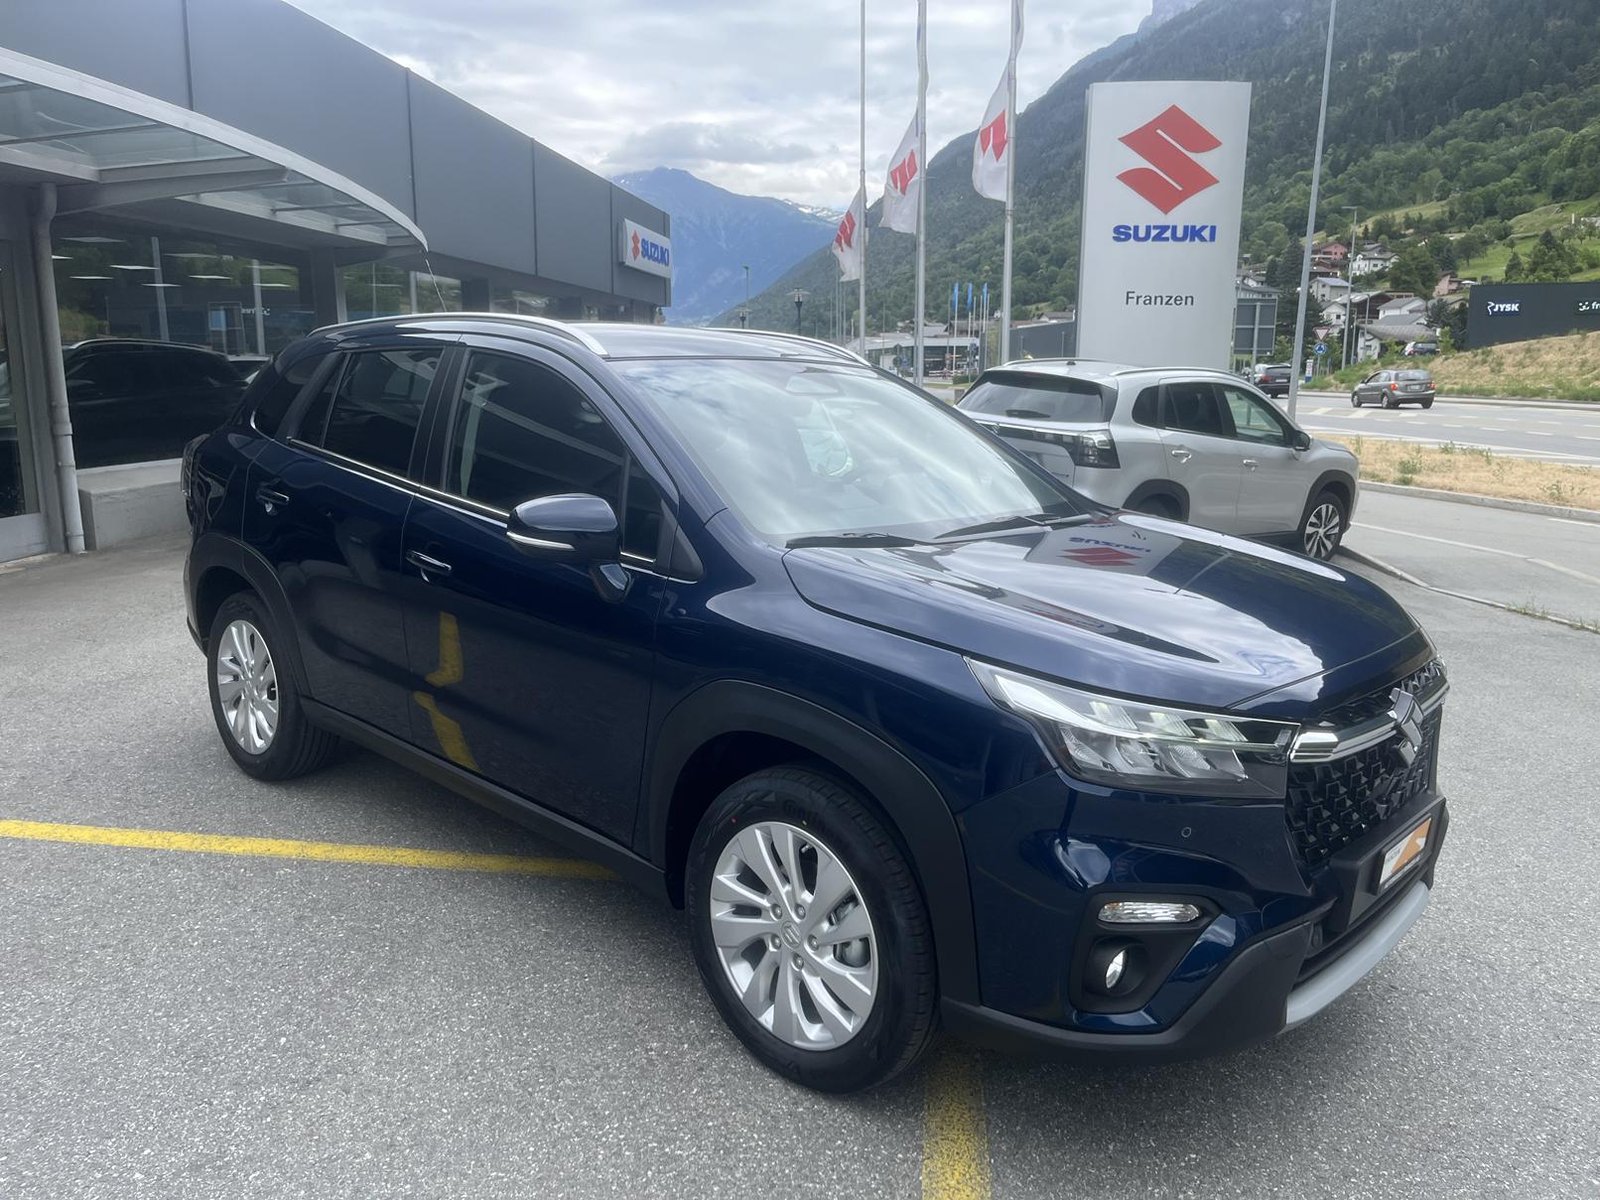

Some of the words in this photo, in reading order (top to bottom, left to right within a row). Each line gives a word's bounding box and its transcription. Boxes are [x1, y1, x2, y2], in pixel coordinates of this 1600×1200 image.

[1112, 224, 1217, 243] SUZUKI
[641, 238, 670, 266] SUZUKI
[1125, 291, 1194, 306] Franzen
[1493, 303, 1520, 312] JYSK
